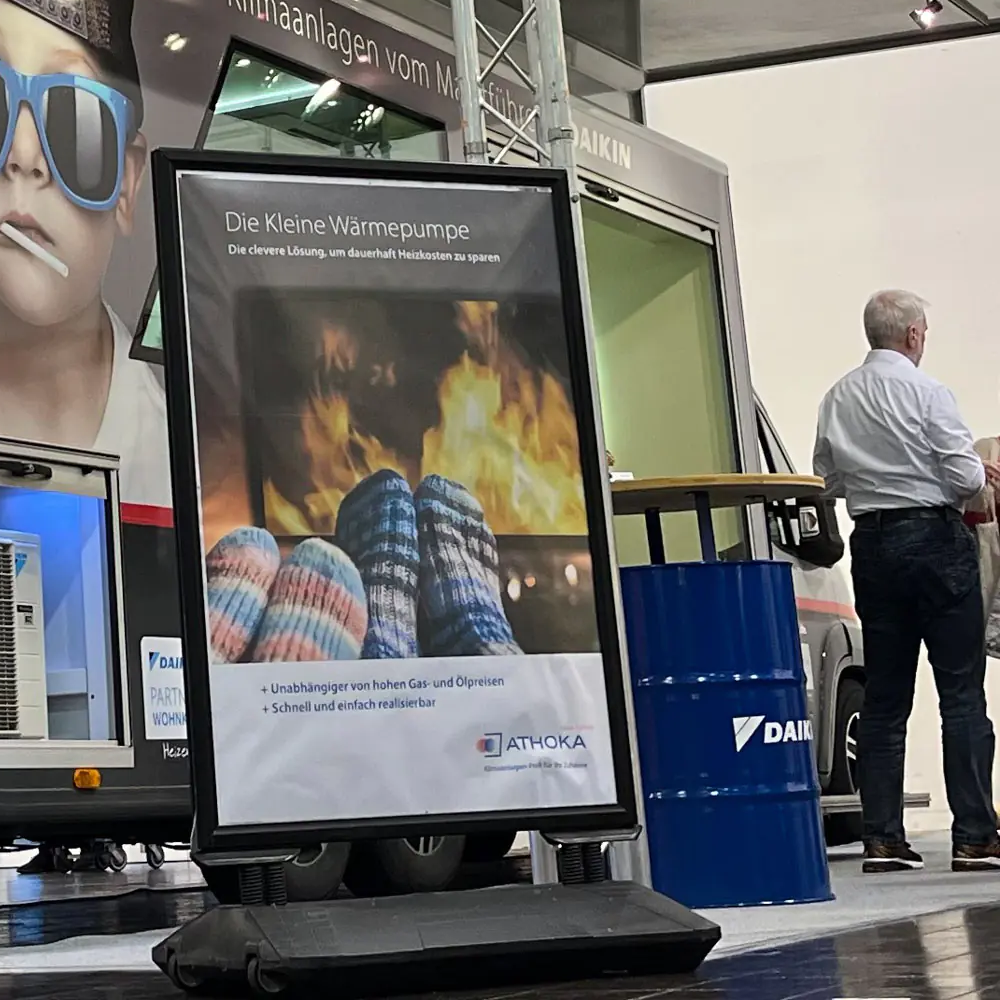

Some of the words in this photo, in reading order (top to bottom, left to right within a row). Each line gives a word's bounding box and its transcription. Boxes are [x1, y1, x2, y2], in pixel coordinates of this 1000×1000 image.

[386, 49, 430, 89] vom
[225, 211, 259, 233] Die
[264, 212, 327, 235] Kleine
[328, 214, 470, 244] Wärmepumpe
[228, 244, 247, 255] Die
[248, 244, 286, 256] clevere
[287, 245, 327, 258] Lösung,
[329, 248, 346, 258] um
[347, 247, 397, 260] dauerhaft
[398, 249, 452, 261] Heizkosten
[453, 252, 466, 262] zu
[467, 252, 501, 265] sparen
[159, 656, 184, 669] DAI
[271, 682, 349, 698] Unabhängiger
[350, 681, 371, 692] von
[372, 678, 407, 692] hohen
[408, 677, 431, 690] Gas-
[433, 676, 454, 689] und
[455, 674, 505, 691] Ölpreisen
[271, 701, 312, 714] Schnell
[314, 700, 335, 713] und
[338, 698, 376, 712] einfach
[377, 697, 437, 710] realisierbar
[506, 734, 587, 753] ATHOKA
